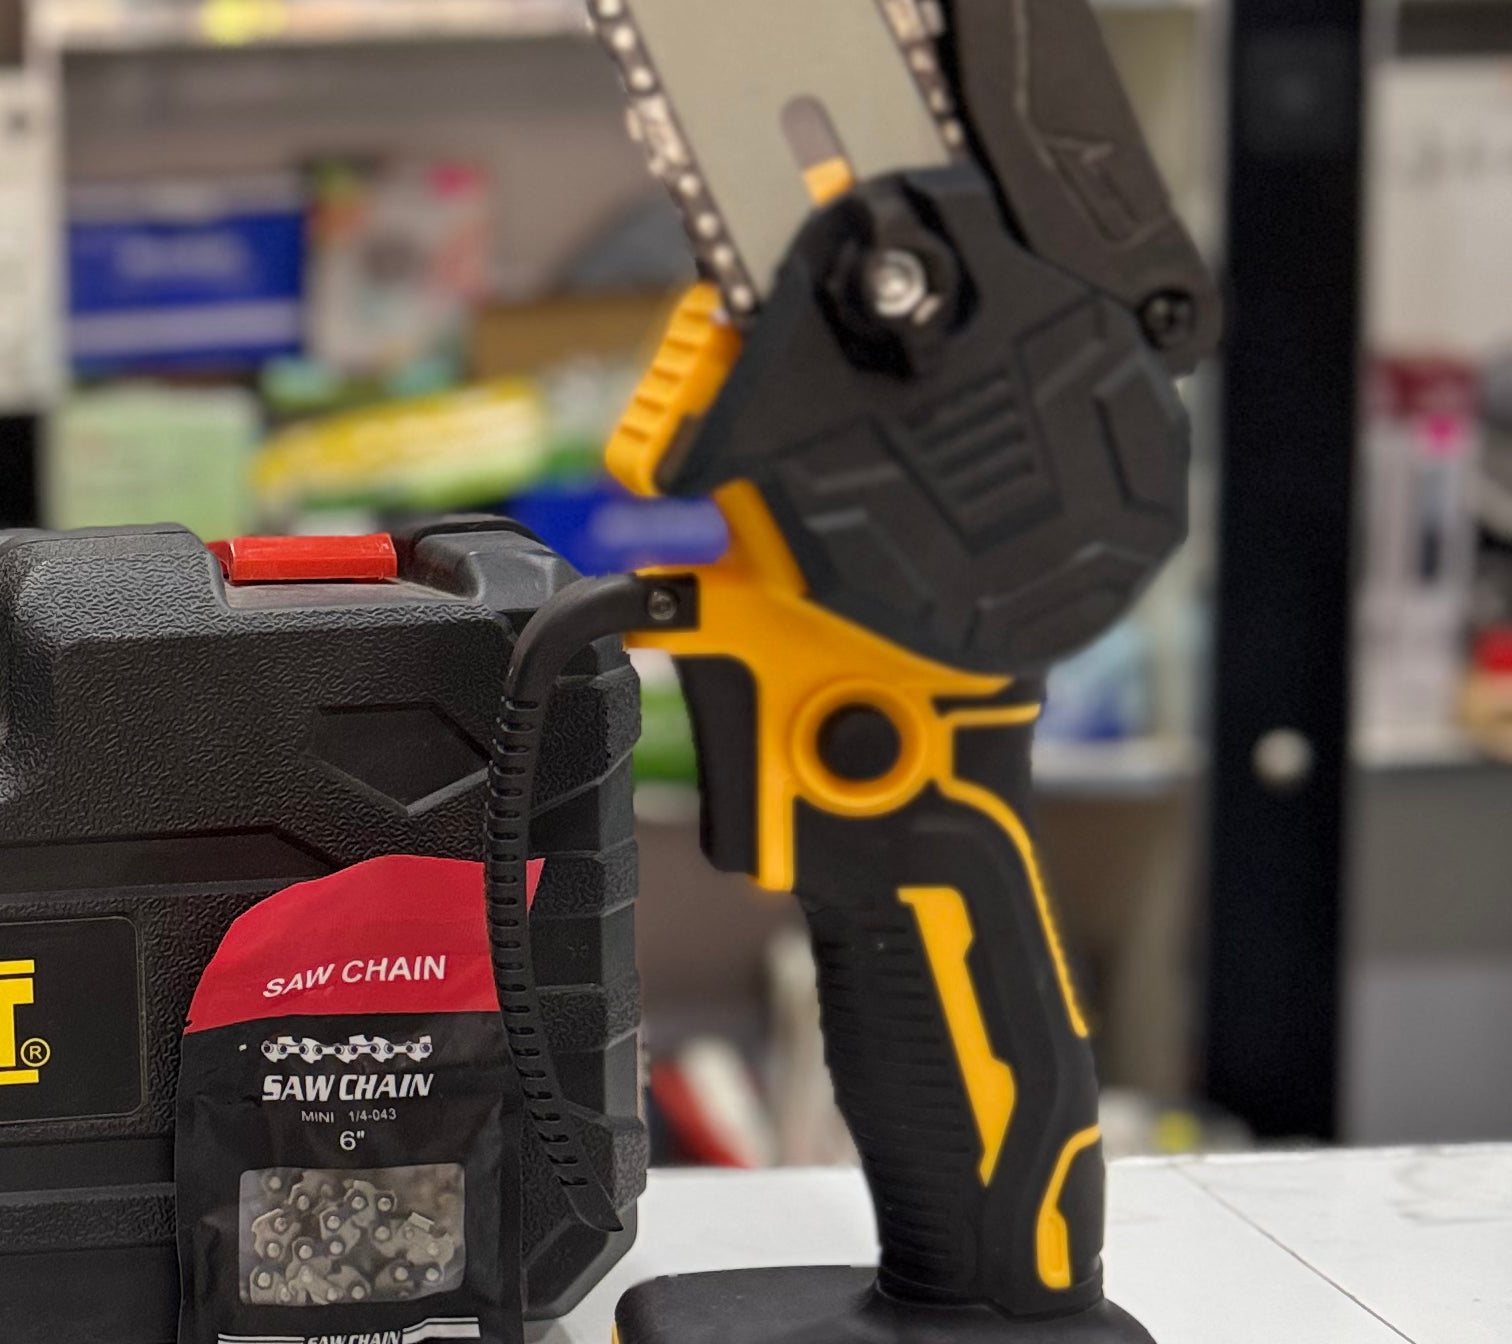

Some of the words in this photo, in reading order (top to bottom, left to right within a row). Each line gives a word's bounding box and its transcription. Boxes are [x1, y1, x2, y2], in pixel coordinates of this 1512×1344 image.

[263, 963, 335, 998] SAW
[341, 954, 446, 983] CHAIN
[262, 1074, 335, 1102] SAW
[339, 1073, 434, 1100] CHAIN
[301, 1110, 335, 1123] MINI
[349, 1107, 397, 1122] 1/4-043
